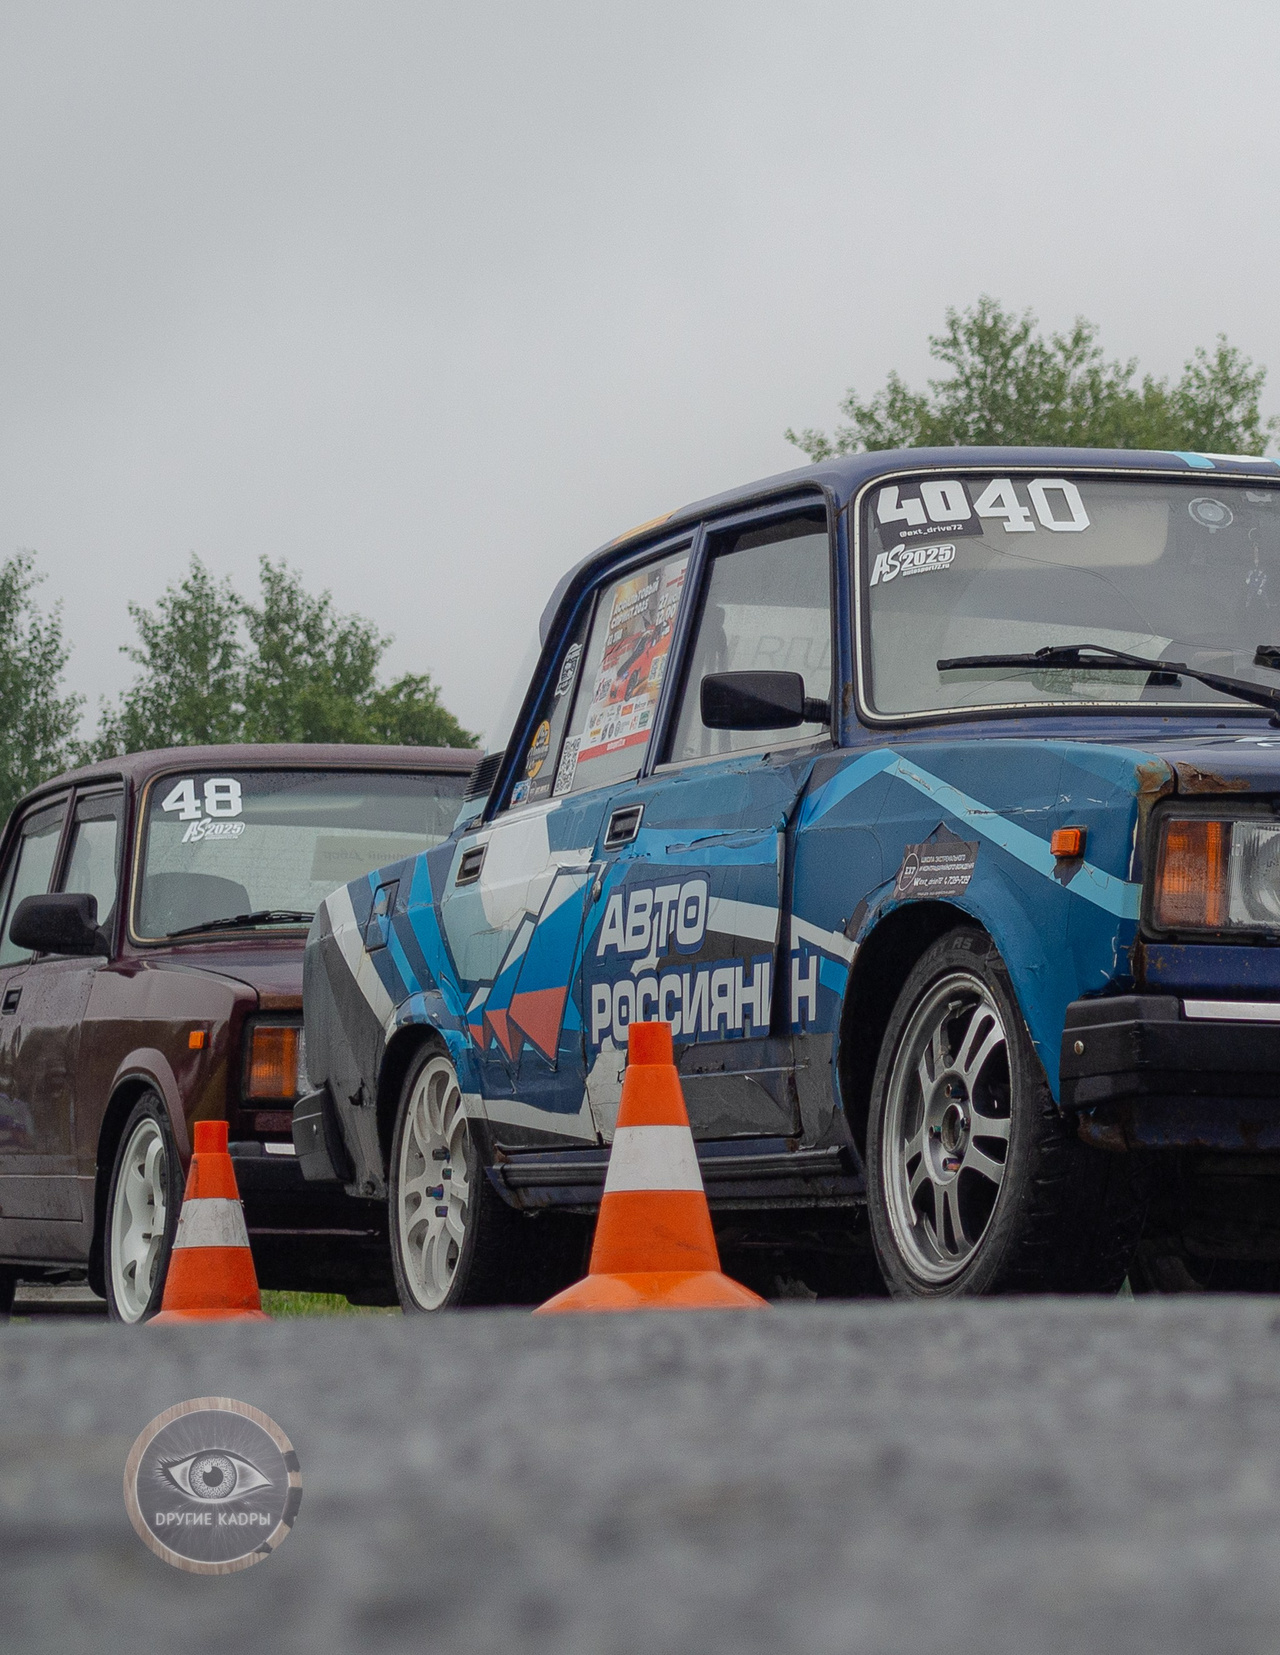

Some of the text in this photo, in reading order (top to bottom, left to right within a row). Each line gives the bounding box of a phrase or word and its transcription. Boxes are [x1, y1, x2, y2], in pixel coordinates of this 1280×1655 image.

[877, 480, 972, 526] 40
[973, 478, 1091, 532] 40
[899, 523, 964, 538] @ext_drive72
[161, 778, 243, 821] 48
[596, 879, 708, 957] АВТО
